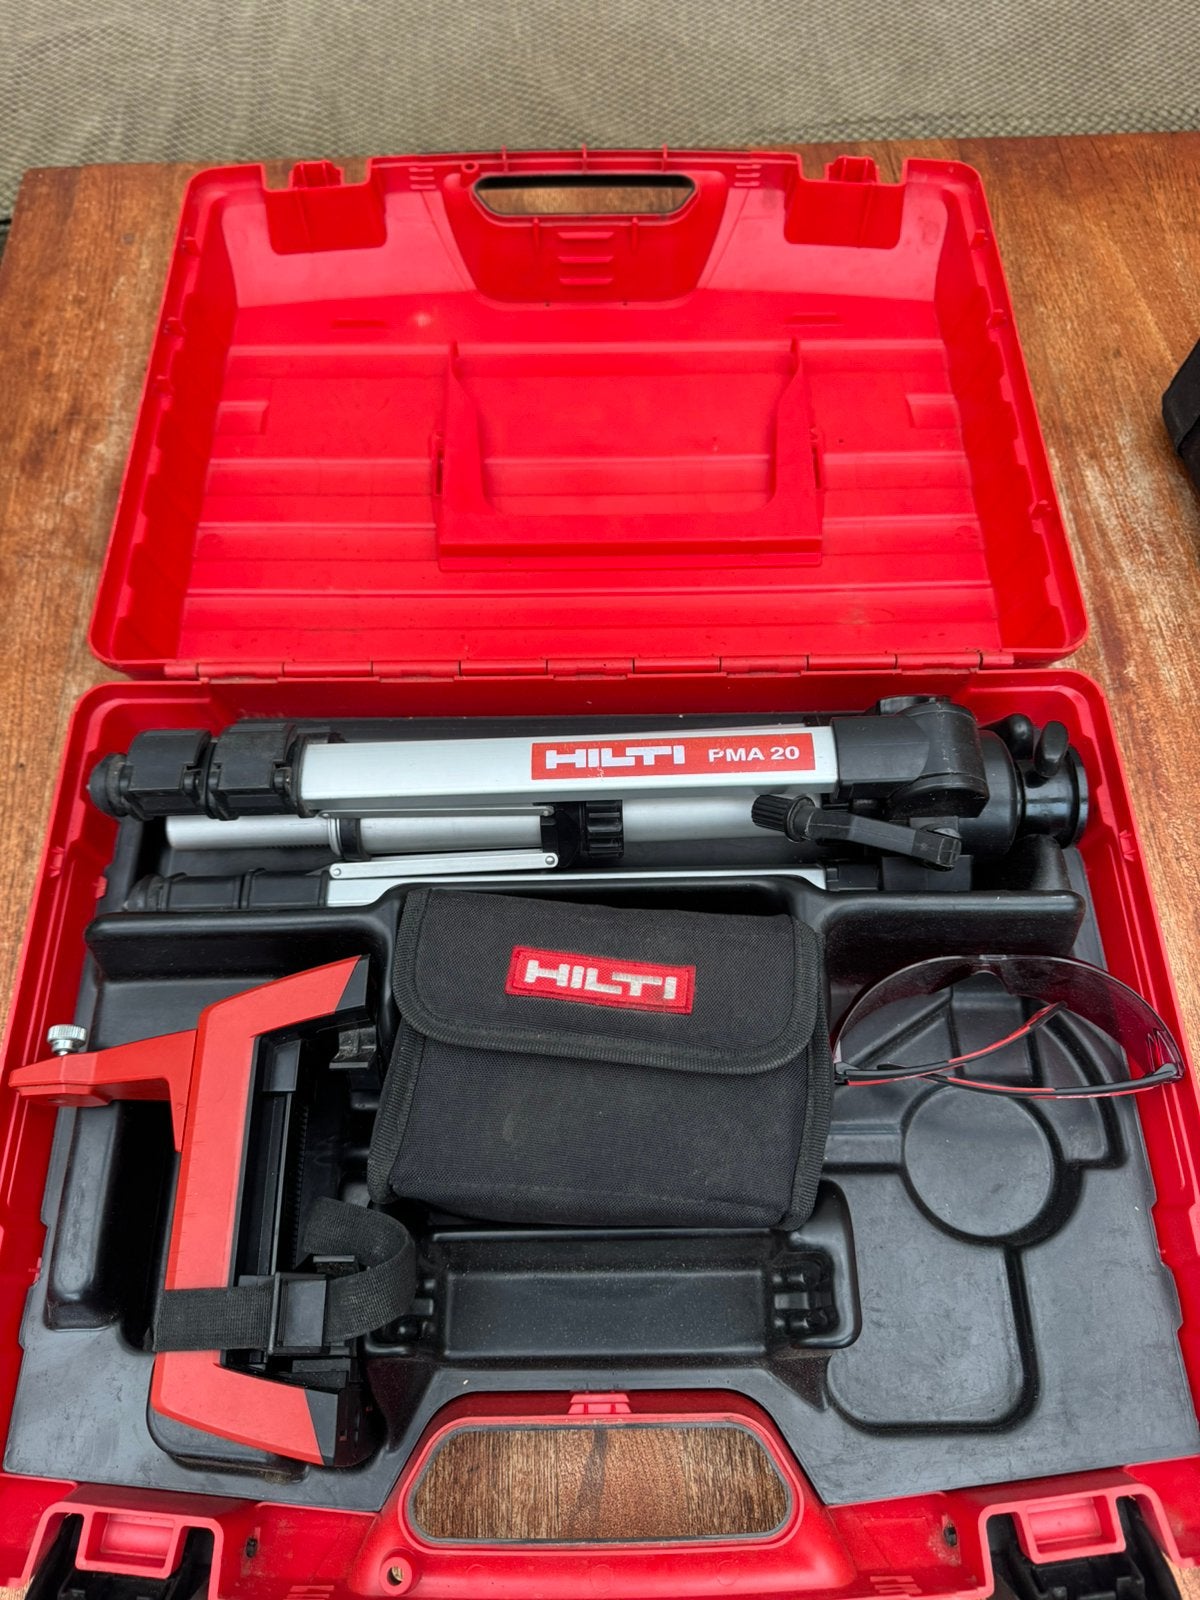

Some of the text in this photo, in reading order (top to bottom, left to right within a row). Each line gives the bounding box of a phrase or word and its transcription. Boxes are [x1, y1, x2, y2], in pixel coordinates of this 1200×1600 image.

[545, 745, 800, 769] HILTI PMA 20
[524, 960, 677, 999] HILTI
